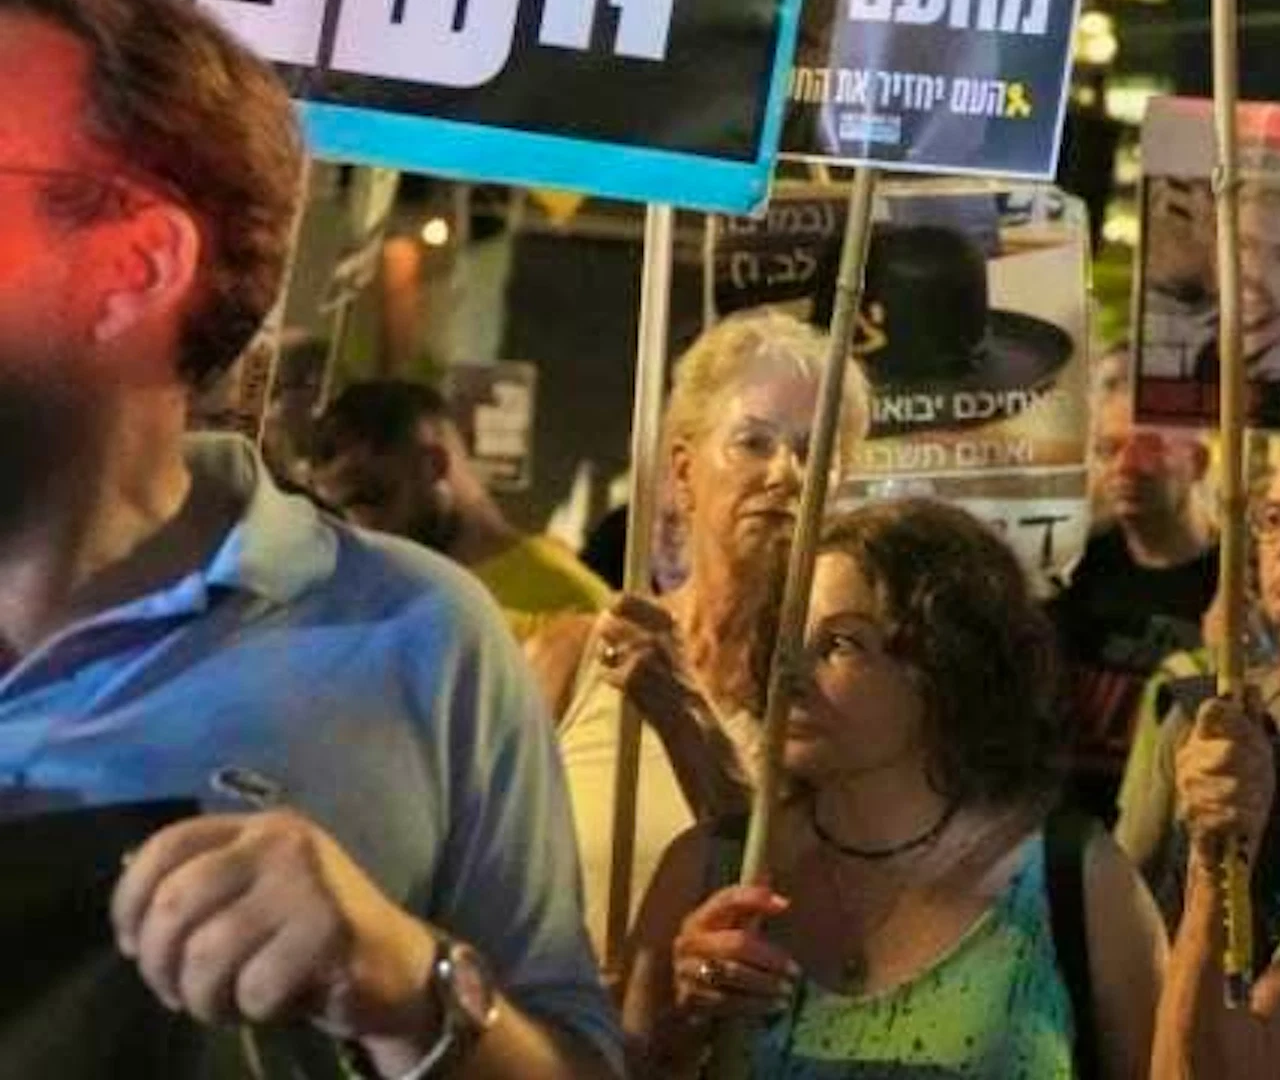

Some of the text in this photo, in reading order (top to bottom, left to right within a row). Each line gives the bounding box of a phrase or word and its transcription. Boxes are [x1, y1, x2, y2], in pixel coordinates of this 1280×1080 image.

[835, 67, 869, 104] את
[950, 77, 1009, 118] העם
[871, 394, 944, 423] יבואו
